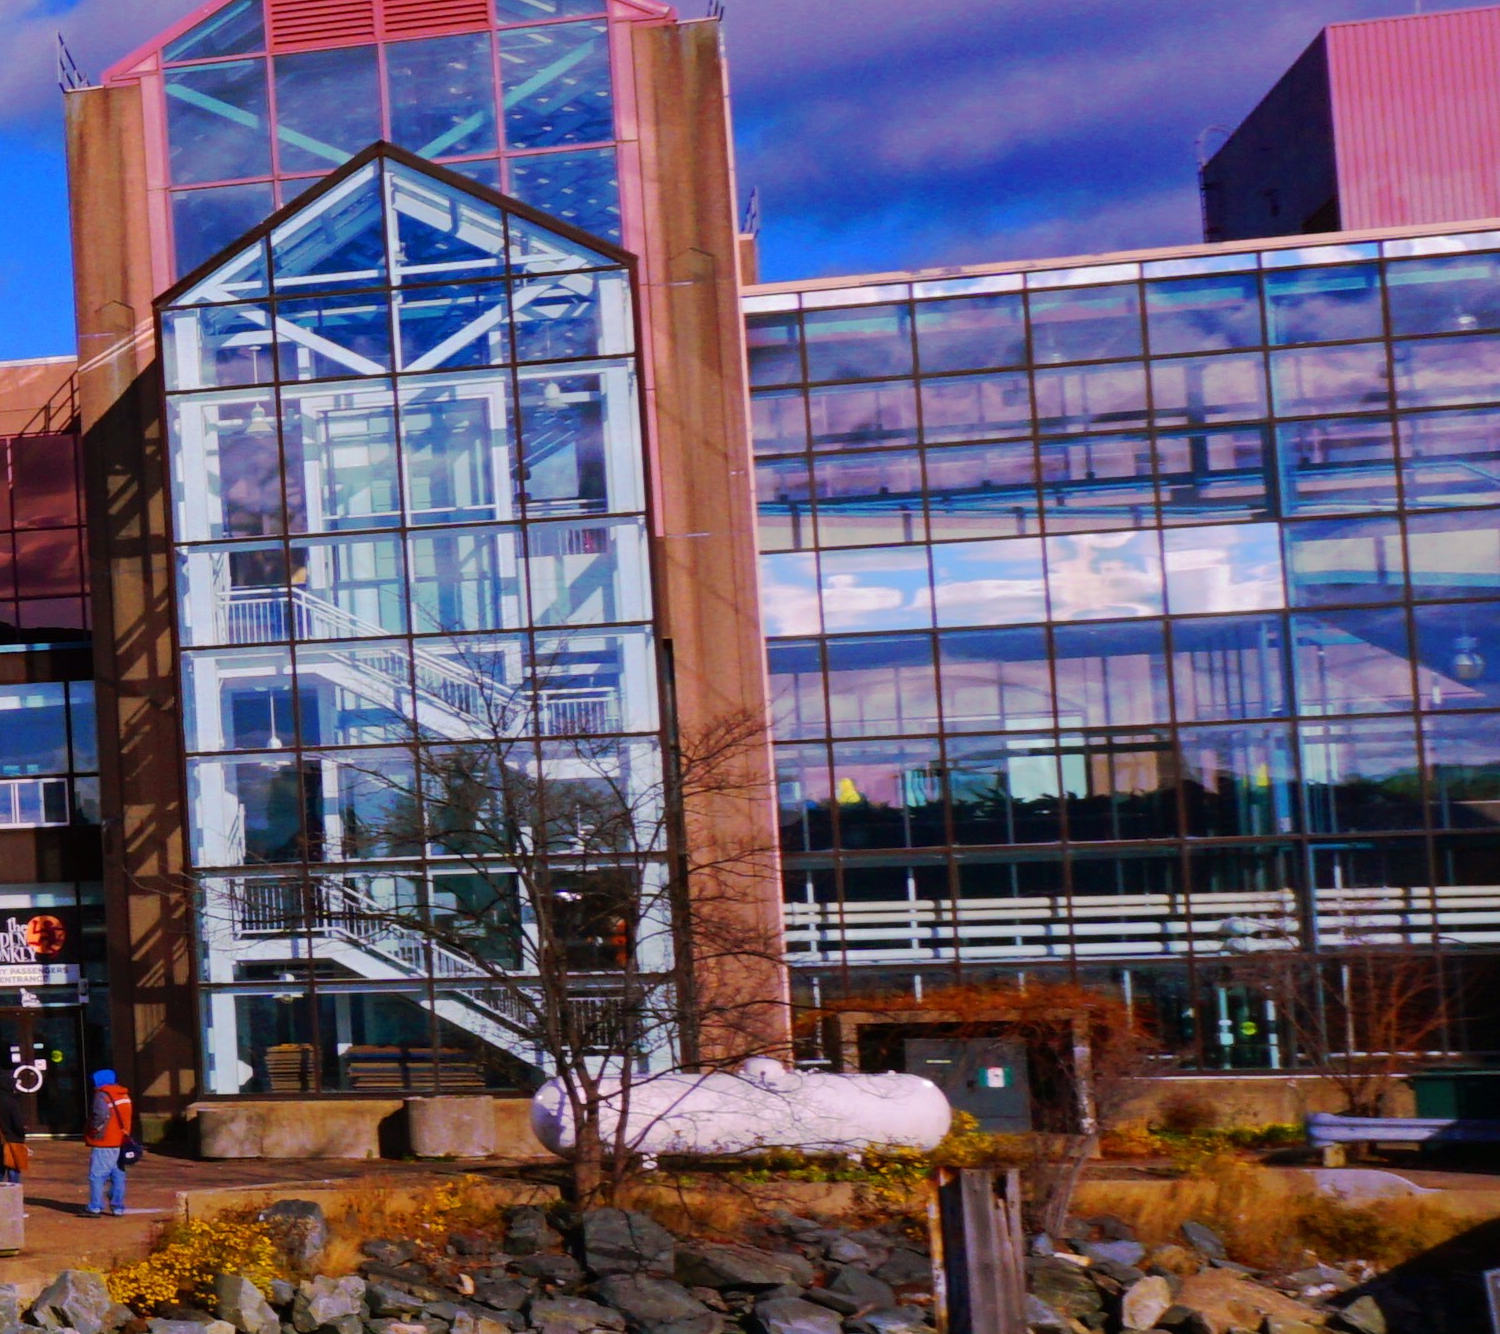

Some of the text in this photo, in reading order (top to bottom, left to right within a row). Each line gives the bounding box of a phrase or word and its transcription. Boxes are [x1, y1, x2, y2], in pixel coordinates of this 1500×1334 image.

[6, 916, 28, 933] the
[10, 966, 68, 976] PASSENGERS
[0, 974, 49, 984] ENTRANCE
